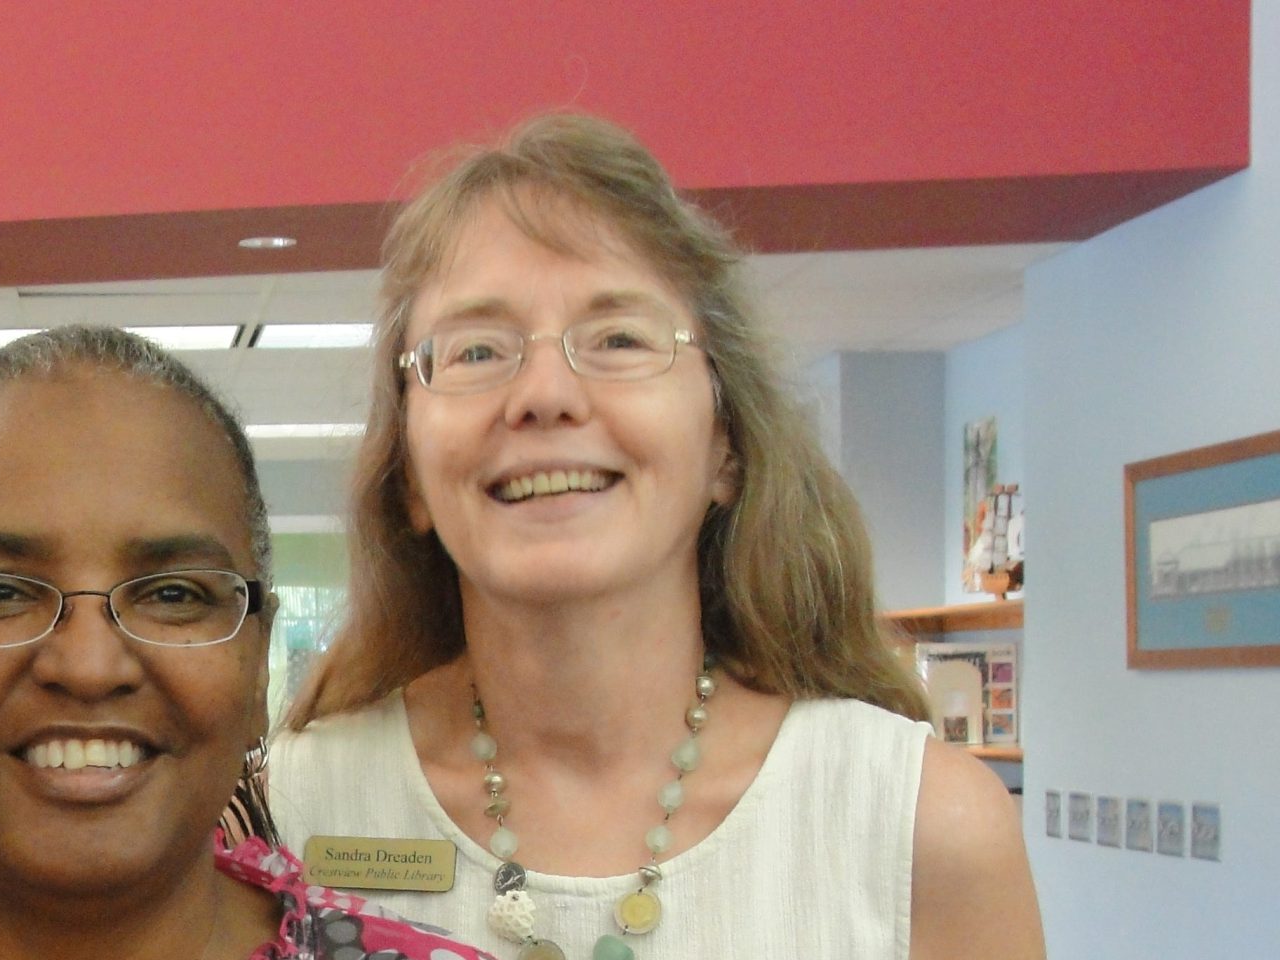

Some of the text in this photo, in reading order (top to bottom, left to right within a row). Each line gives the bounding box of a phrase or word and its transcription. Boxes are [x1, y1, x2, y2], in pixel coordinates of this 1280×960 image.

[324, 847, 432, 864] Sandra Dreaden
[365, 867, 400, 880] Public
[403, 869, 446, 884] Library
